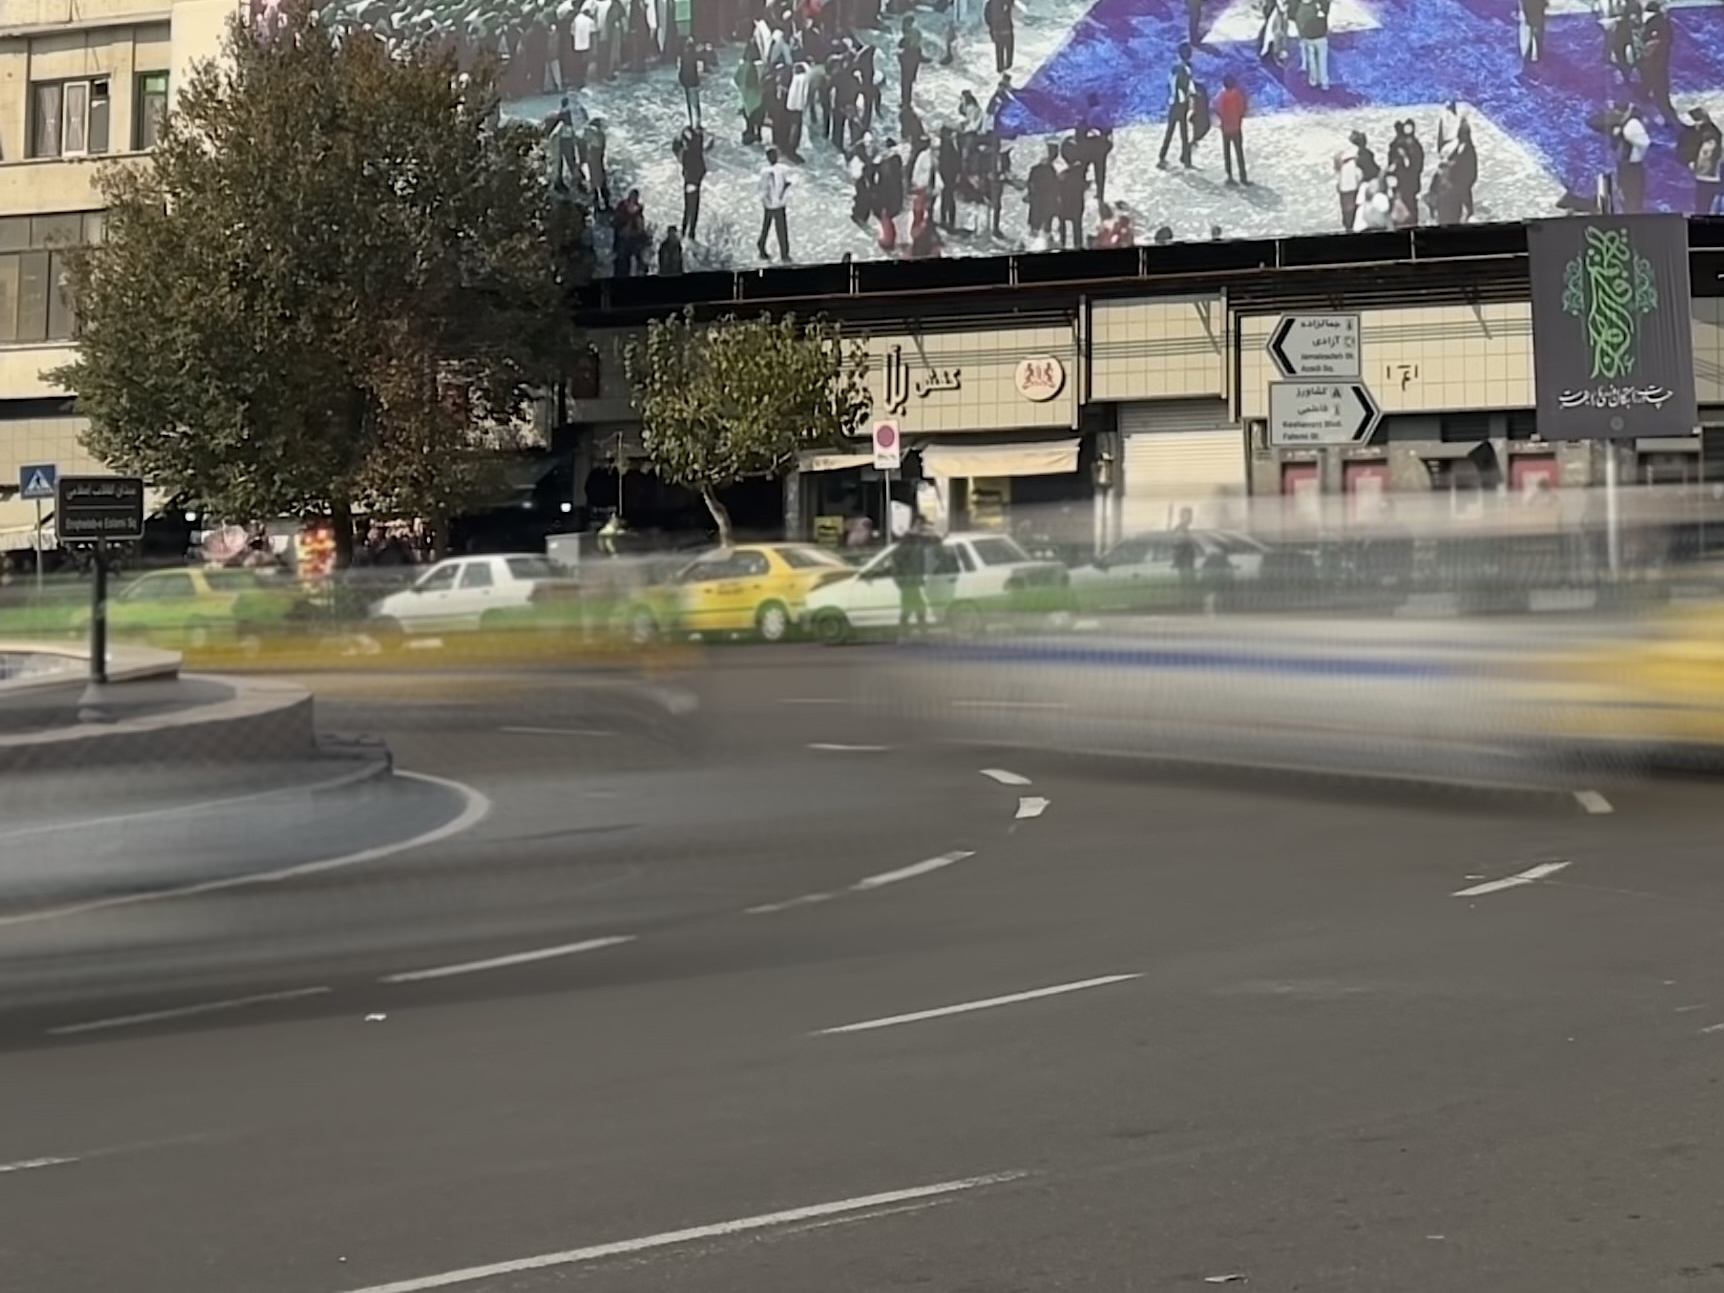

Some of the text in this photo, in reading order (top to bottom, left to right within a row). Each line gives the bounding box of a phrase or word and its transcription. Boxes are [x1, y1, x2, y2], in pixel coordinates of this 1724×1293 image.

[1312, 335, 1341, 348] آزادی
[914, 368, 961, 398] کفش
[1296, 387, 1329, 399] کشاورز
